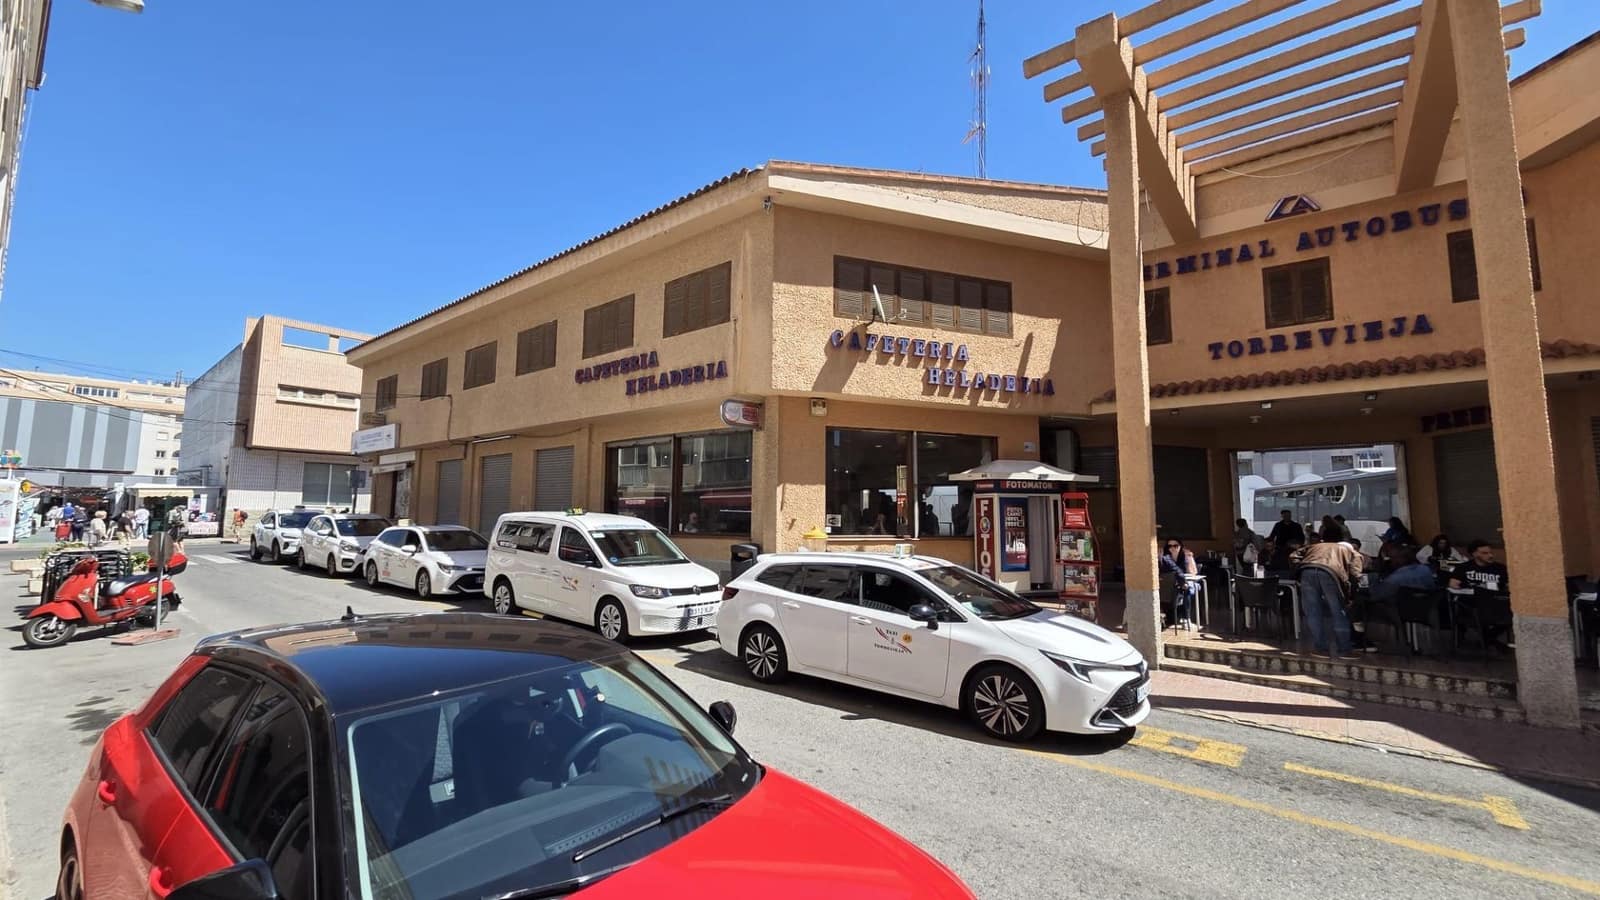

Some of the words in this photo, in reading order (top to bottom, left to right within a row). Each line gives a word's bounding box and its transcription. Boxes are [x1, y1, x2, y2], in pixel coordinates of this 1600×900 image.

[1143, 239, 1276, 281] ERMINAL
[831, 329, 970, 362] CAFETERIA
[1208, 313, 1434, 360] TORREVIEJA
[574, 351, 660, 385] CAFETERIA
[625, 360, 729, 396] HELADERIA
